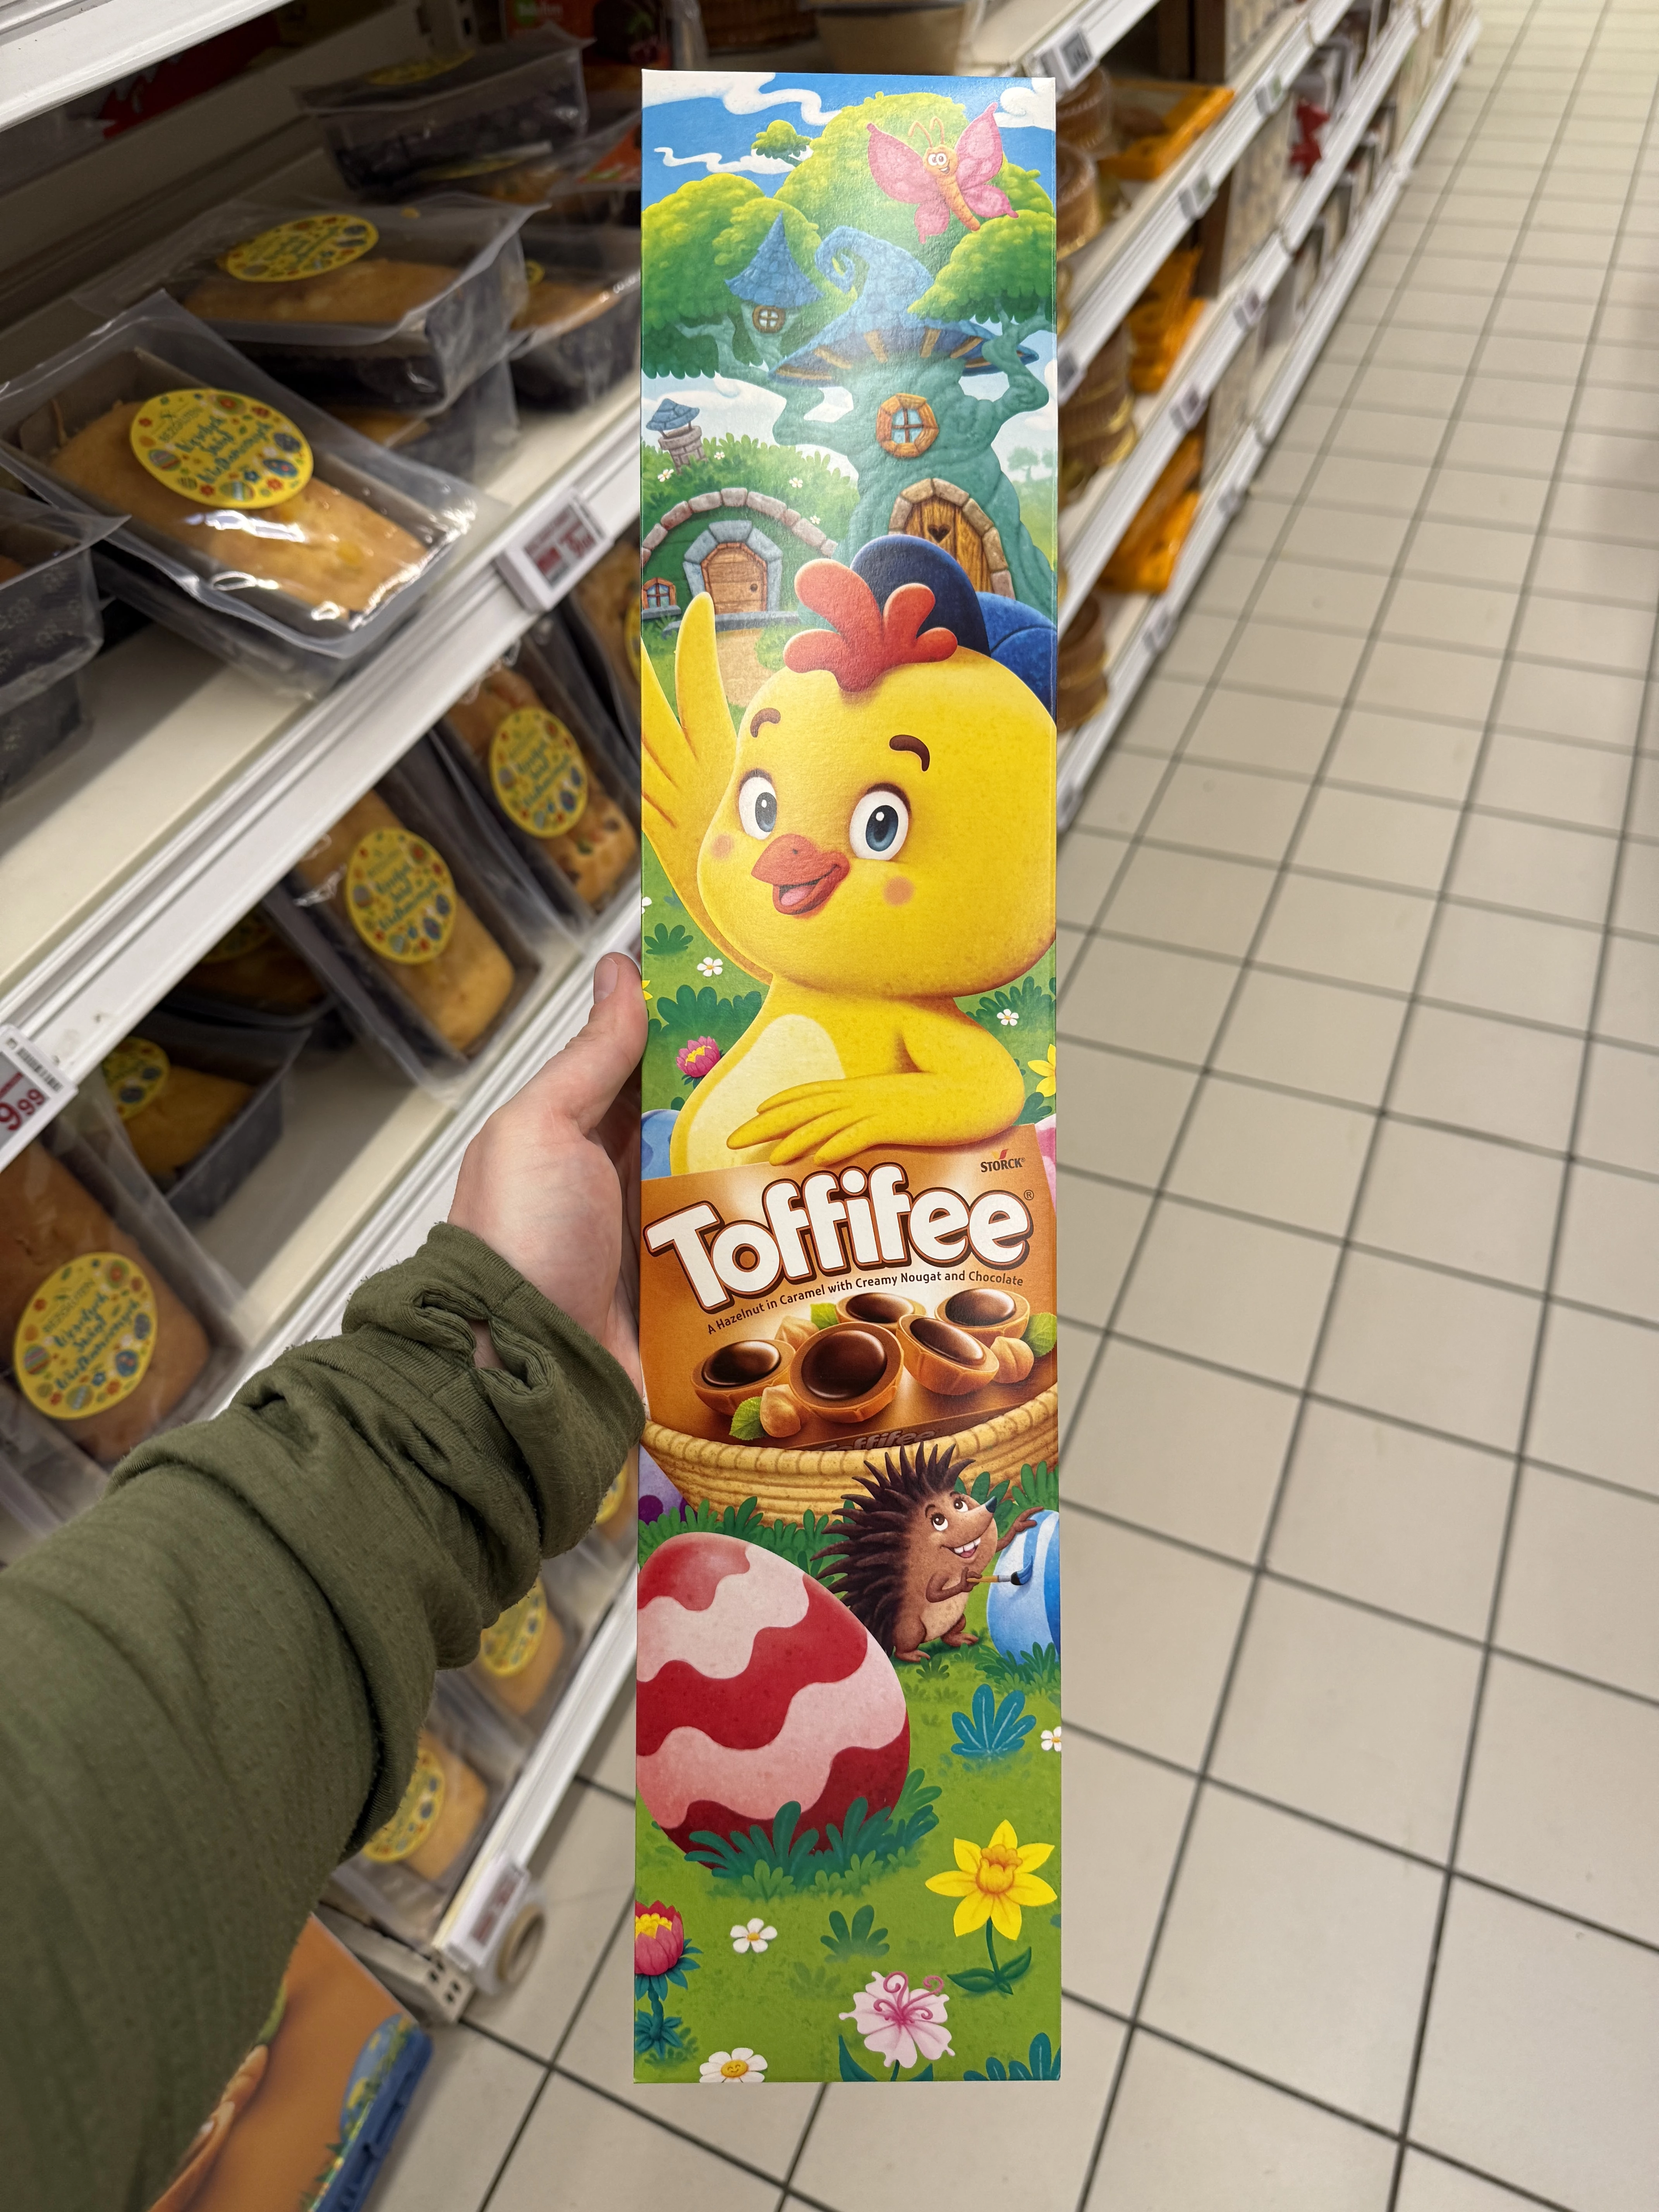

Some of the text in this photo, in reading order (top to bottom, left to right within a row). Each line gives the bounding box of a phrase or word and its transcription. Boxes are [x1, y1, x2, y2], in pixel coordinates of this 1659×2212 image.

[980, 1158, 1023, 1173] STORCK
[643, 1162, 1034, 1313] Toffifee
[708, 1270, 1024, 1335] A Hazelnut in Caramel with Creamy Nougat and Chocolate
